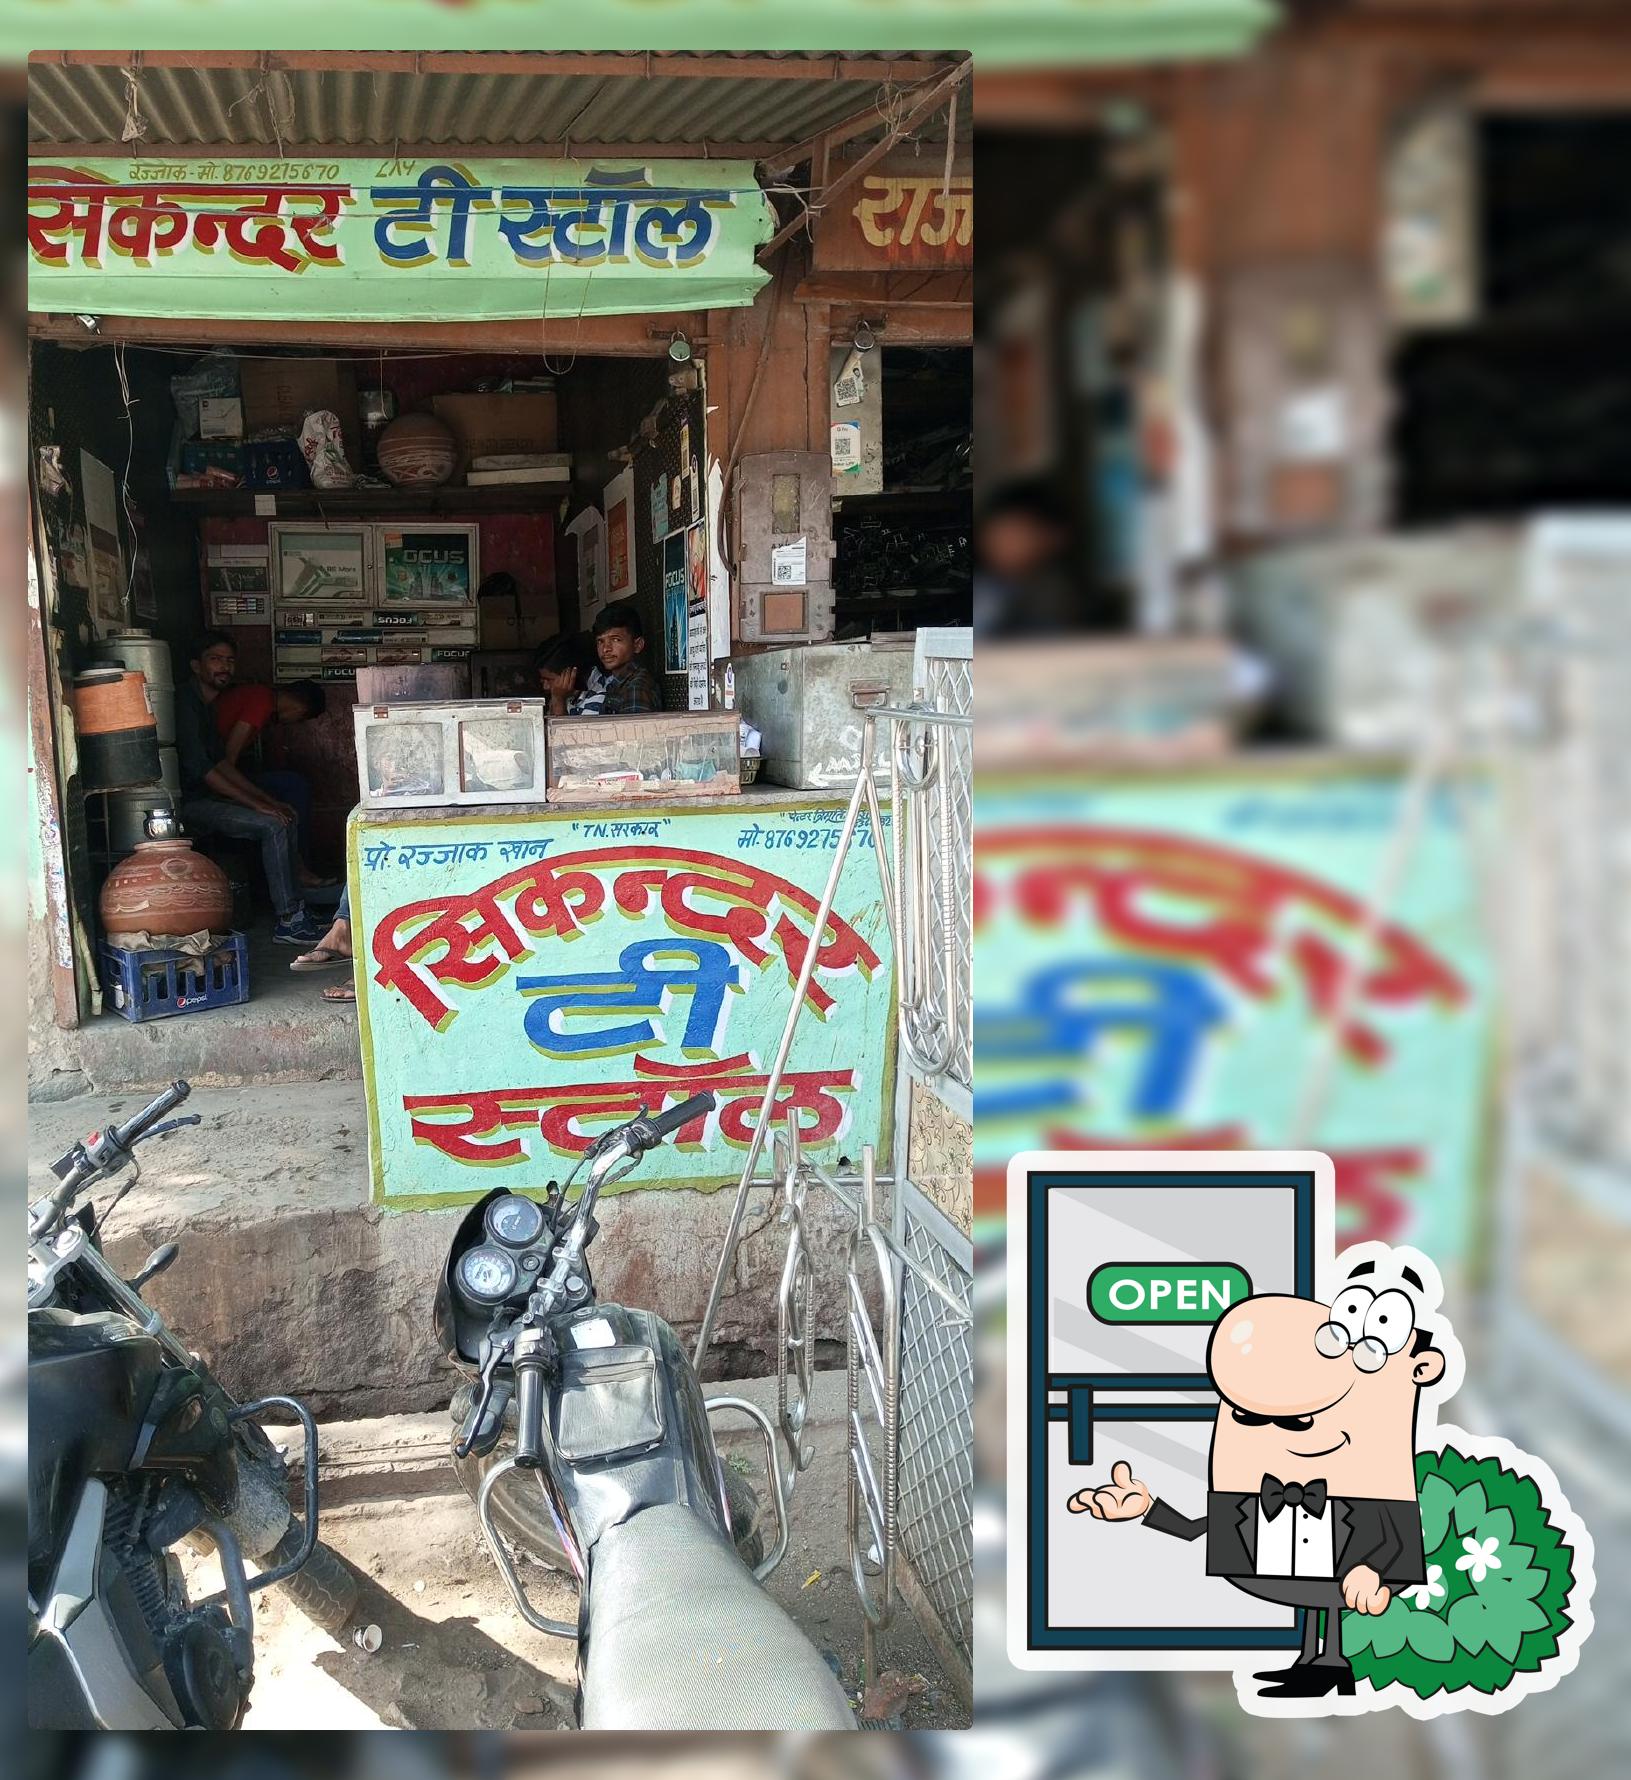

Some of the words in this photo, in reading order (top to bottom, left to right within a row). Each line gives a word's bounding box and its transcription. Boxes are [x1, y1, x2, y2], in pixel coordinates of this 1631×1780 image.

[370, 165, 496, 268] टी
[498, 167, 736, 268] स्टॉल
[373, 846, 883, 1032] सिकन्दर
[516, 938, 744, 1058] टी
